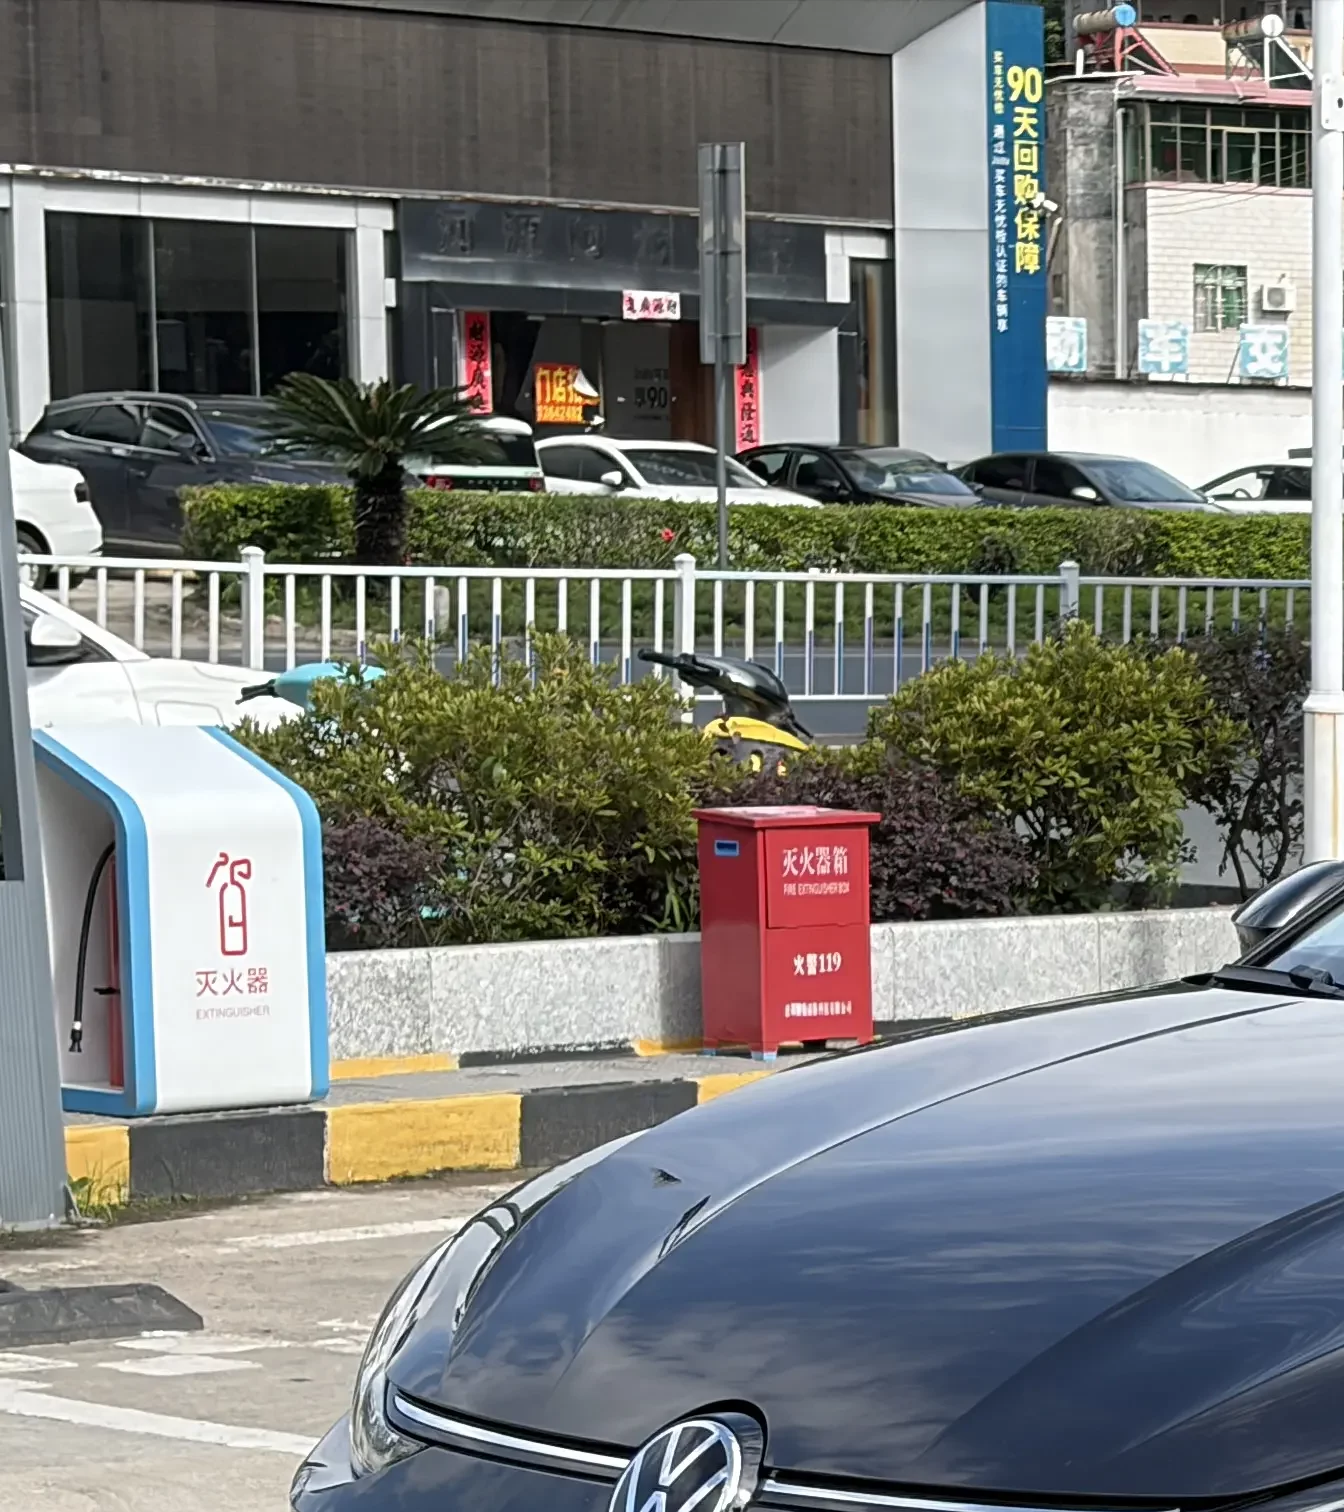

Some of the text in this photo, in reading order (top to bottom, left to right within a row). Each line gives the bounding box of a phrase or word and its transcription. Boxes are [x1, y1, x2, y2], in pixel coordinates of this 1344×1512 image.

[783, 846, 849, 878] 灭火器箱
[793, 952, 842, 976] 火警119
[196, 967, 269, 997] 灭火器
[196, 1005, 270, 1020] EXTINGUISHER
